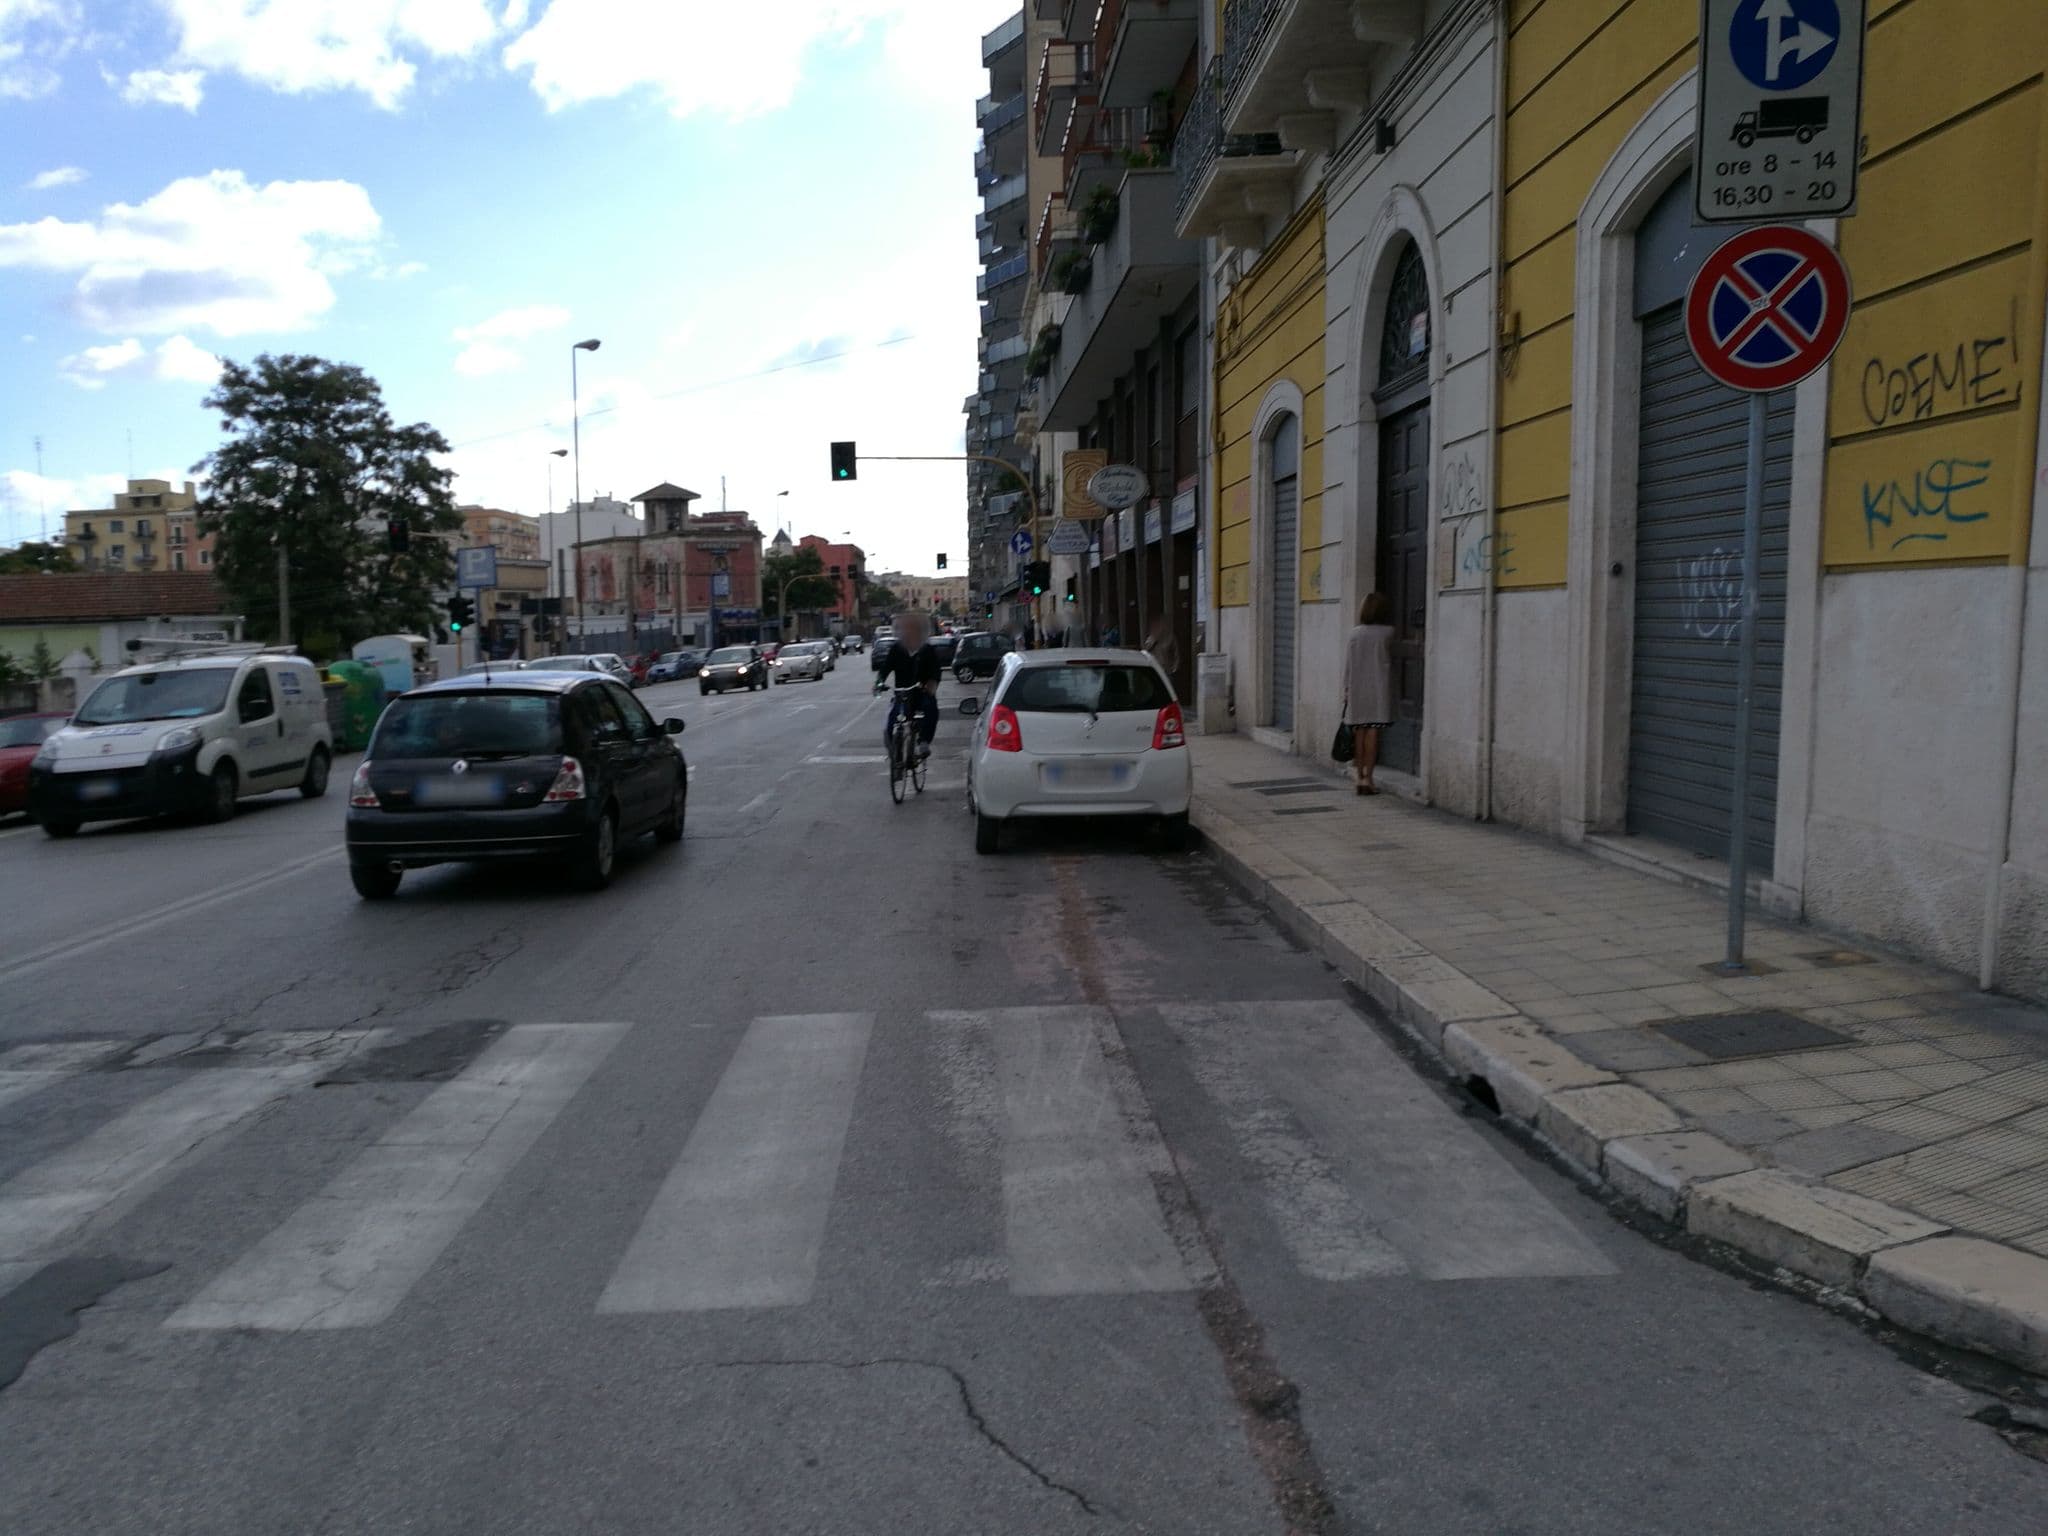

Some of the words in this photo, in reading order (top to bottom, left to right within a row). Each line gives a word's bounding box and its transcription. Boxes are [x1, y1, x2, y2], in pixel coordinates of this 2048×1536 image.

[1715, 160, 1751, 176] ore
[1763, 153, 1779, 173] 8
[1813, 150, 1837, 170] 14
[1807, 180, 1837, 201] 20
